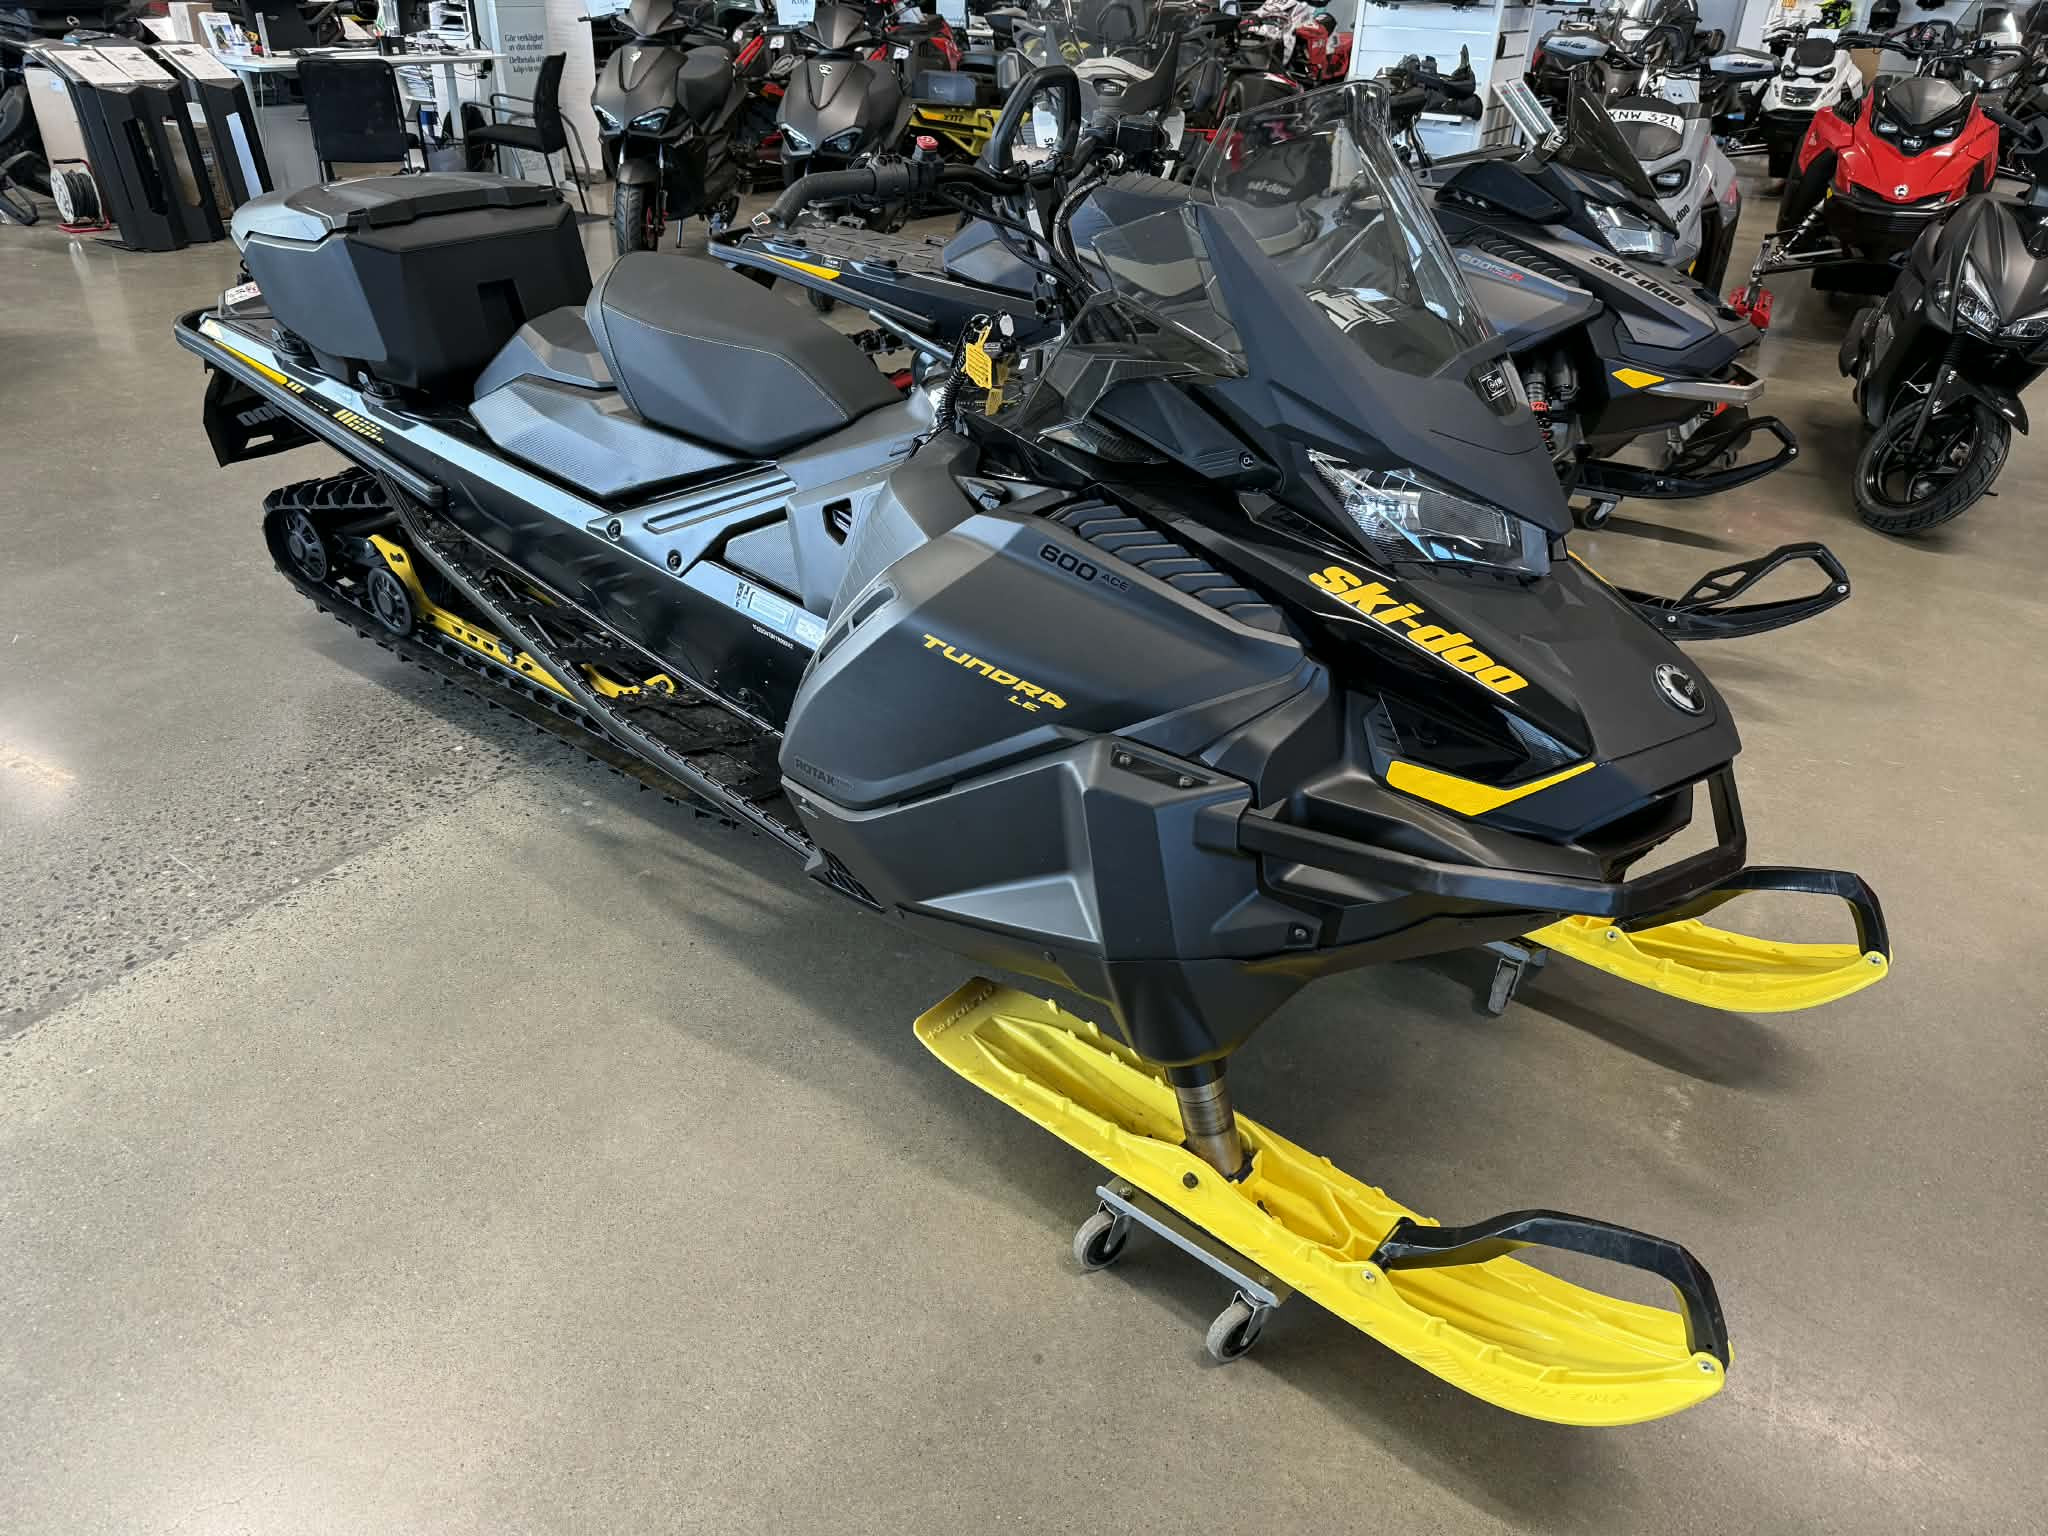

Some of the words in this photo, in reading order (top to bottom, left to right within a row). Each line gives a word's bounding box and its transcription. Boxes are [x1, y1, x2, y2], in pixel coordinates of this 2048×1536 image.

[1589, 256, 1687, 307] ski-doo
[1040, 544, 1098, 581] 600
[1101, 573, 1129, 592] ACE
[1308, 566, 1529, 694] ski-doo
[1008, 695, 1041, 712] LE
